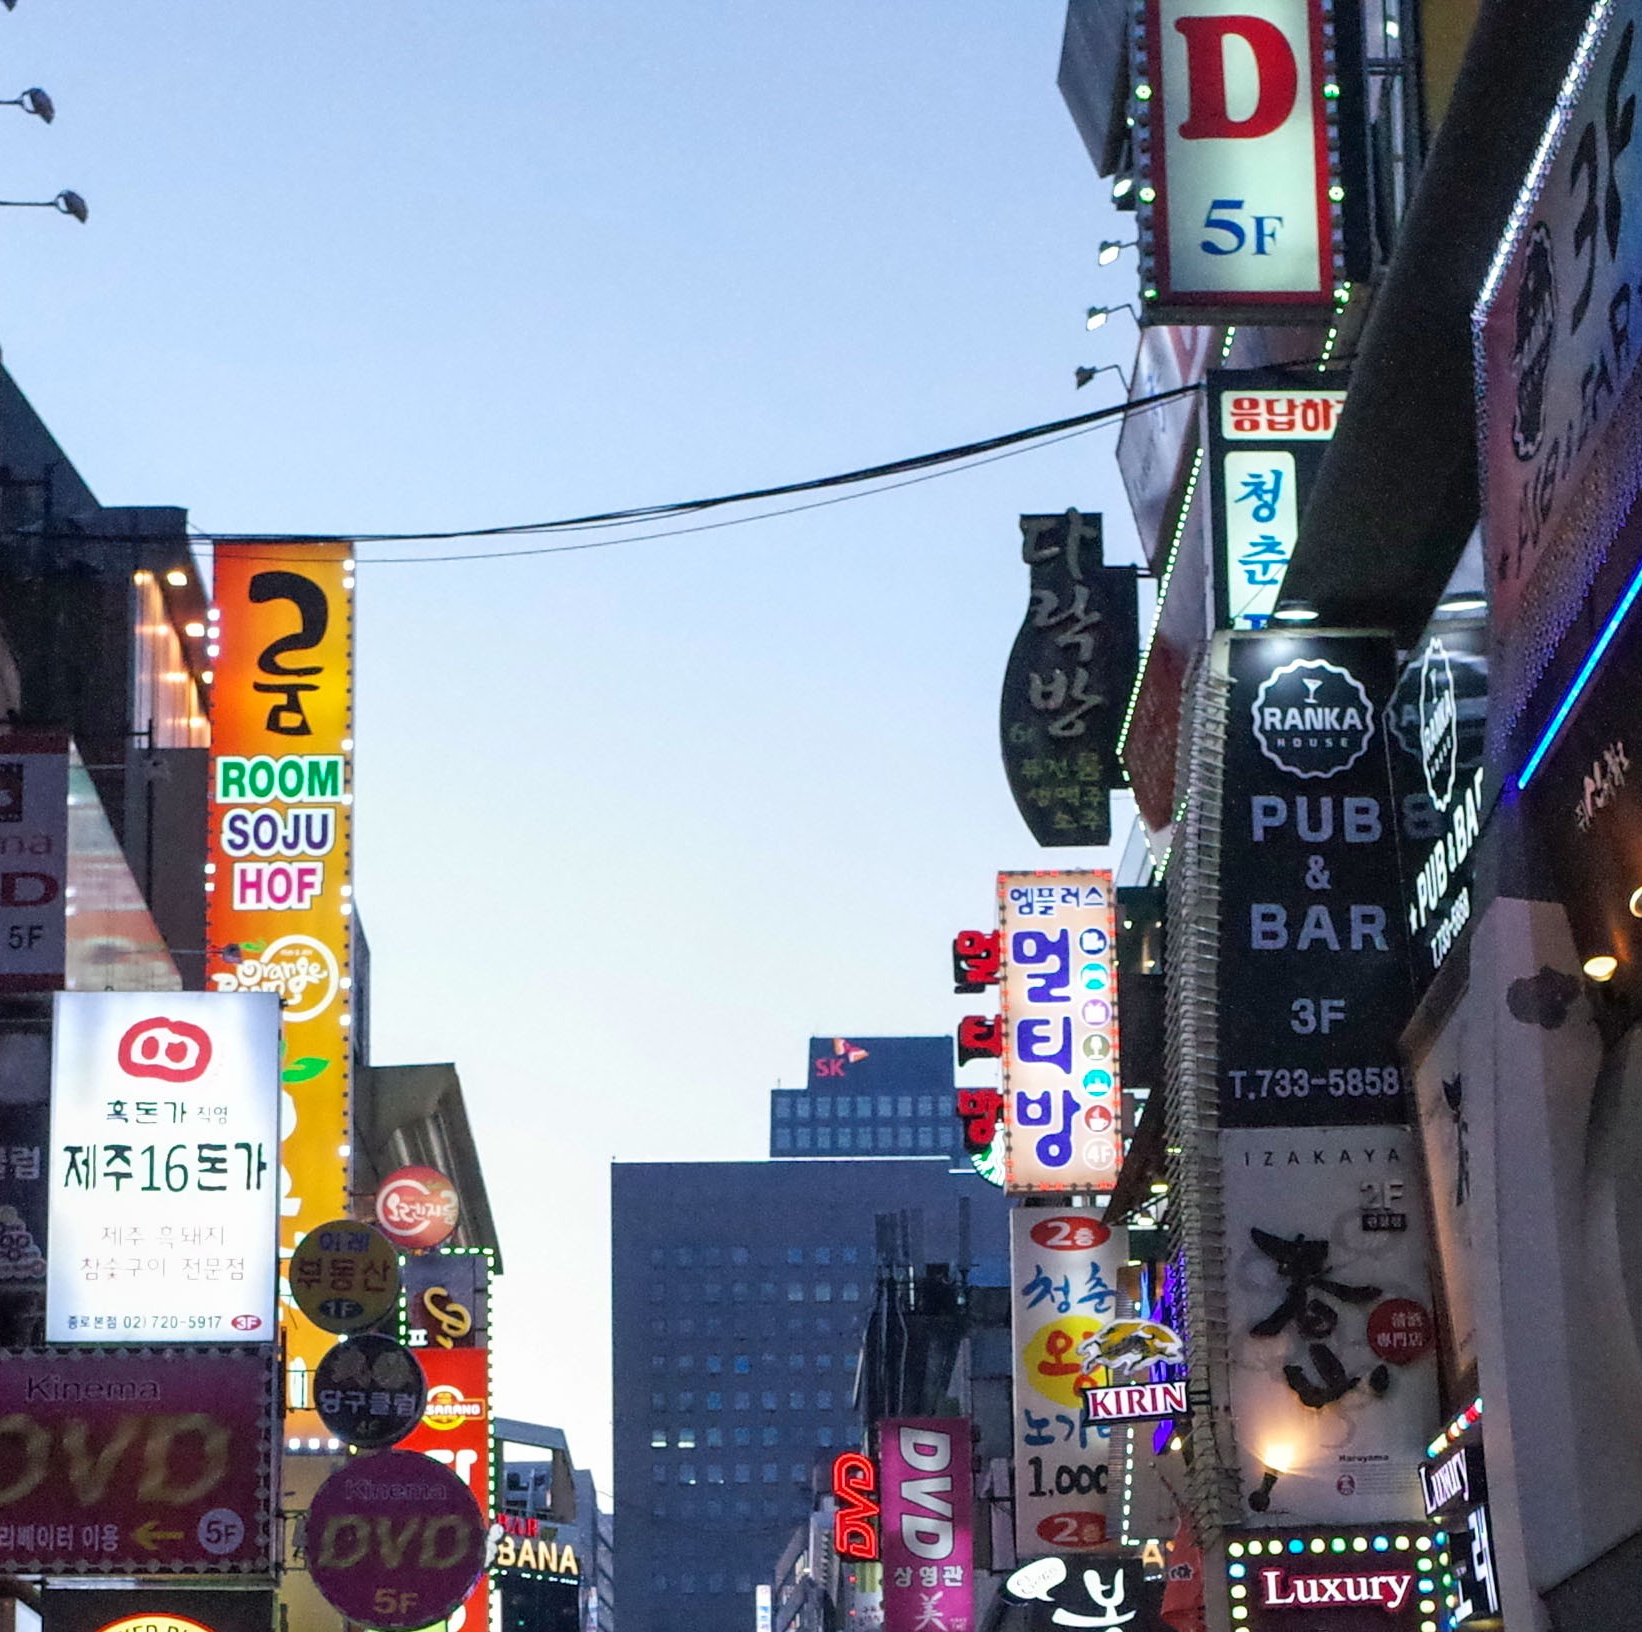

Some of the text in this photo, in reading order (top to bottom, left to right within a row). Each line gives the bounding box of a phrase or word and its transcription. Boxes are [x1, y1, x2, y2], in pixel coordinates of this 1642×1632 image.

[1175, 16, 1297, 140] D
[1200, 199, 1284, 256] 5F
[1230, 396, 1347, 433] 응답하
[1019, 507, 1104, 738] 다락방
[249, 571, 328, 736] 룸
[1263, 704, 1364, 732] RANKA
[1276, 737, 1350, 750] HOUSE
[222, 760, 339, 799] ROOM
[225, 811, 330, 853] SOJU
[1250, 796, 1383, 843] PUB
[238, 865, 318, 906] HOF
[1304, 855, 1332, 891] &
[1010, 886, 1104, 916] 엠플러스
[8, 924, 44, 950] 5F
[1250, 904, 1388, 951] BAR
[236, 956, 328, 991] Orange
[1290, 999, 1347, 1036] 3F
[814, 1057, 846, 1078] SK
[1228, 1068, 1400, 1099] T.733-5858
[106, 1099, 188, 1125] 흑돈가
[62, 1142, 268, 1193] 제주16돈가
[1244, 1149, 1401, 1167] IZAKAYA
[1360, 1179, 1405, 1211] 2F
[100, 1225, 146, 1247] 제주
[1045, 1221, 1096, 1247] 2층
[79, 1256, 246, 1281] 참숯구이 전문점
[297, 1258, 390, 1293] 부동산
[1021, 1261, 1117, 1315] 청춘
[68, 1314, 258, 1331] 종로본점 02)720-5917 3F
[25, 1374, 161, 1402] Kinema
[1088, 1383, 1187, 1420] KIRIN
[425, 1403, 481, 1416] SARANG
[343, 1478, 447, 1501] Kinema
[898, 1426, 954, 1561] DVD
[1422, 1448, 1470, 1516] Luxury
[832, 1451, 881, 1561] DVD
[82, 1523, 120, 1551] 이용
[206, 1519, 238, 1545] 5F
[316, 1514, 472, 1569] DVD
[893, 1565, 964, 1588] 상영관
[1262, 1569, 1412, 1609] Luxury
[372, 1588, 420, 1614] 5F
[913, 1591, 949, 1632] 美
